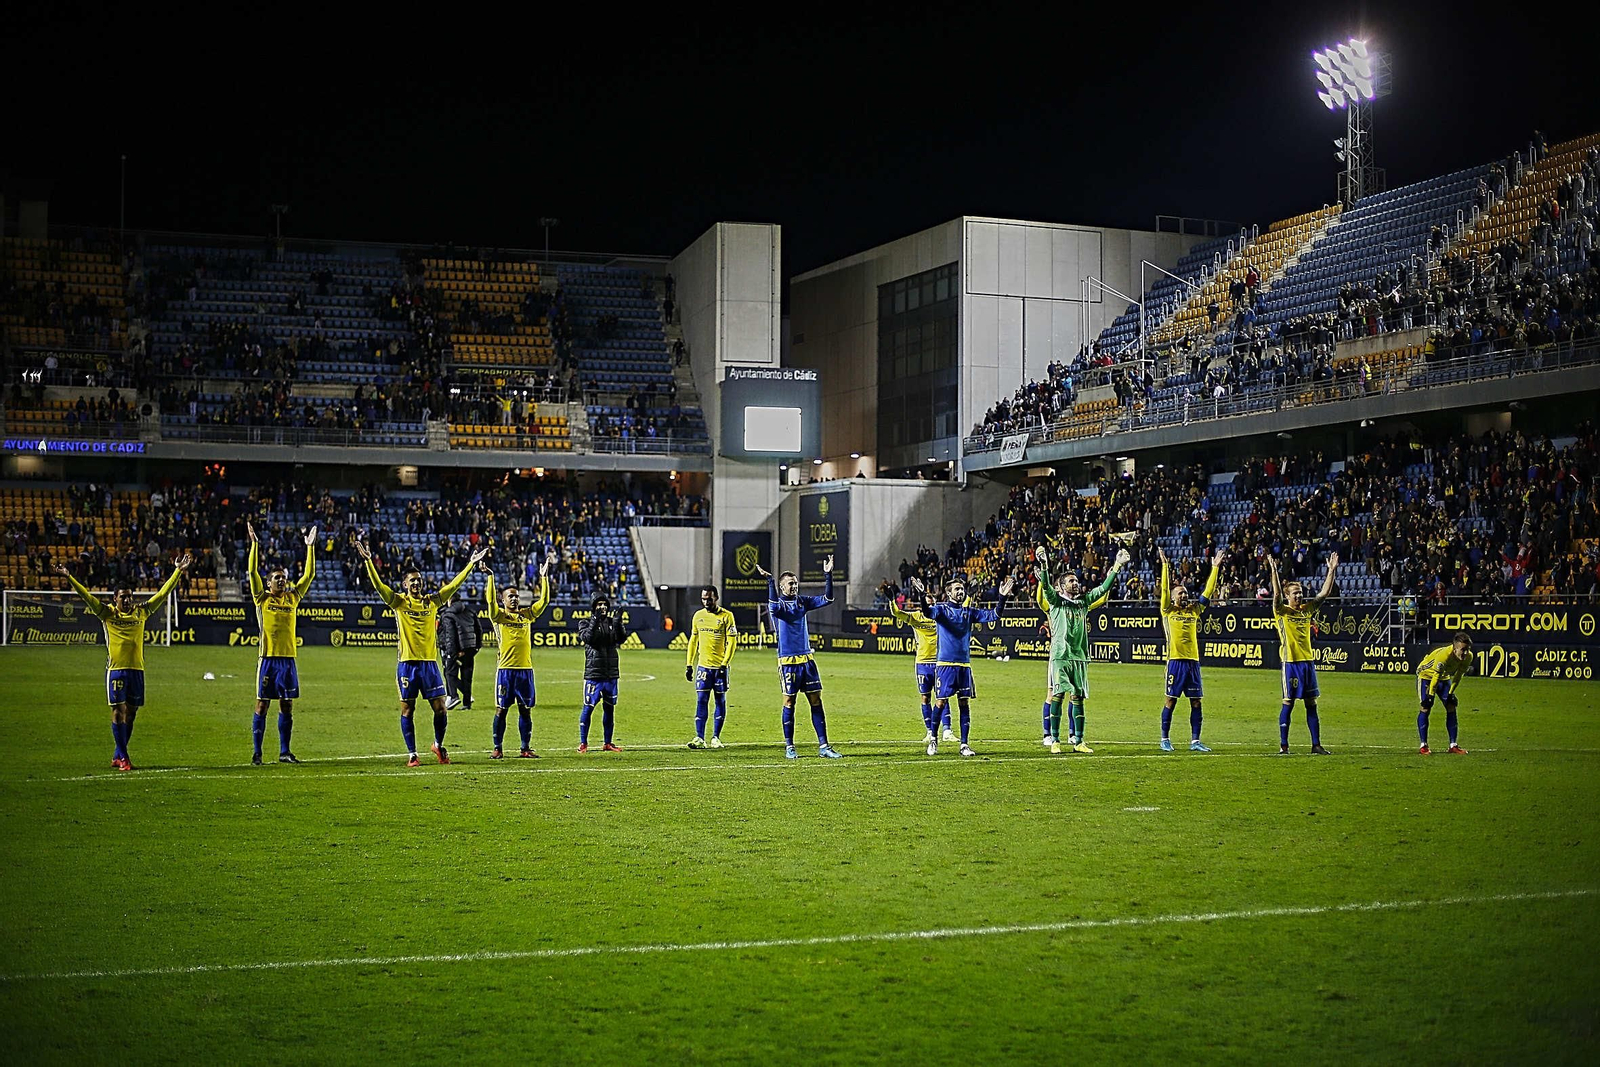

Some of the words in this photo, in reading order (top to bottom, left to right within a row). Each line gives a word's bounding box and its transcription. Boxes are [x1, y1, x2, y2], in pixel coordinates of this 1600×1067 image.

[729, 368, 782, 380] Ayuntamiento
[783, 370, 792, 379] de
[794, 370, 817, 380] Cádiz
[93, 442, 107, 452] DE
[810, 524, 838, 542] TOBBA
[184, 606, 246, 616] ALMADRABA
[296, 608, 344, 616] MADRABA
[1000, 617, 1038, 628] TORROT
[1112, 618, 1158, 628] TORROT
[1431, 612, 1568, 632] TORROT.COM
[346, 631, 376, 640] PETACA
[877, 636, 904, 651] TOYOTA
[906, 638, 916, 652] GA
[1132, 644, 1142, 654] LA
[1142, 644, 1156, 655] VOZ
[1204, 642, 1262, 658] EUROPEA
[1090, 644, 1120, 660] LIMPS
[1322, 646, 1348, 664] Radler
[1364, 644, 1390, 658] CÁDIZ
[1392, 647, 1406, 658] C.F.
[1535, 648, 1567, 662] CÁDIZ
[1570, 650, 1588, 662] C.F.
[696, 670, 707, 681] 24
[1168, 674, 1174, 685] 3
[112, 680, 124, 692] 19
[936, 676, 941, 688] 6
